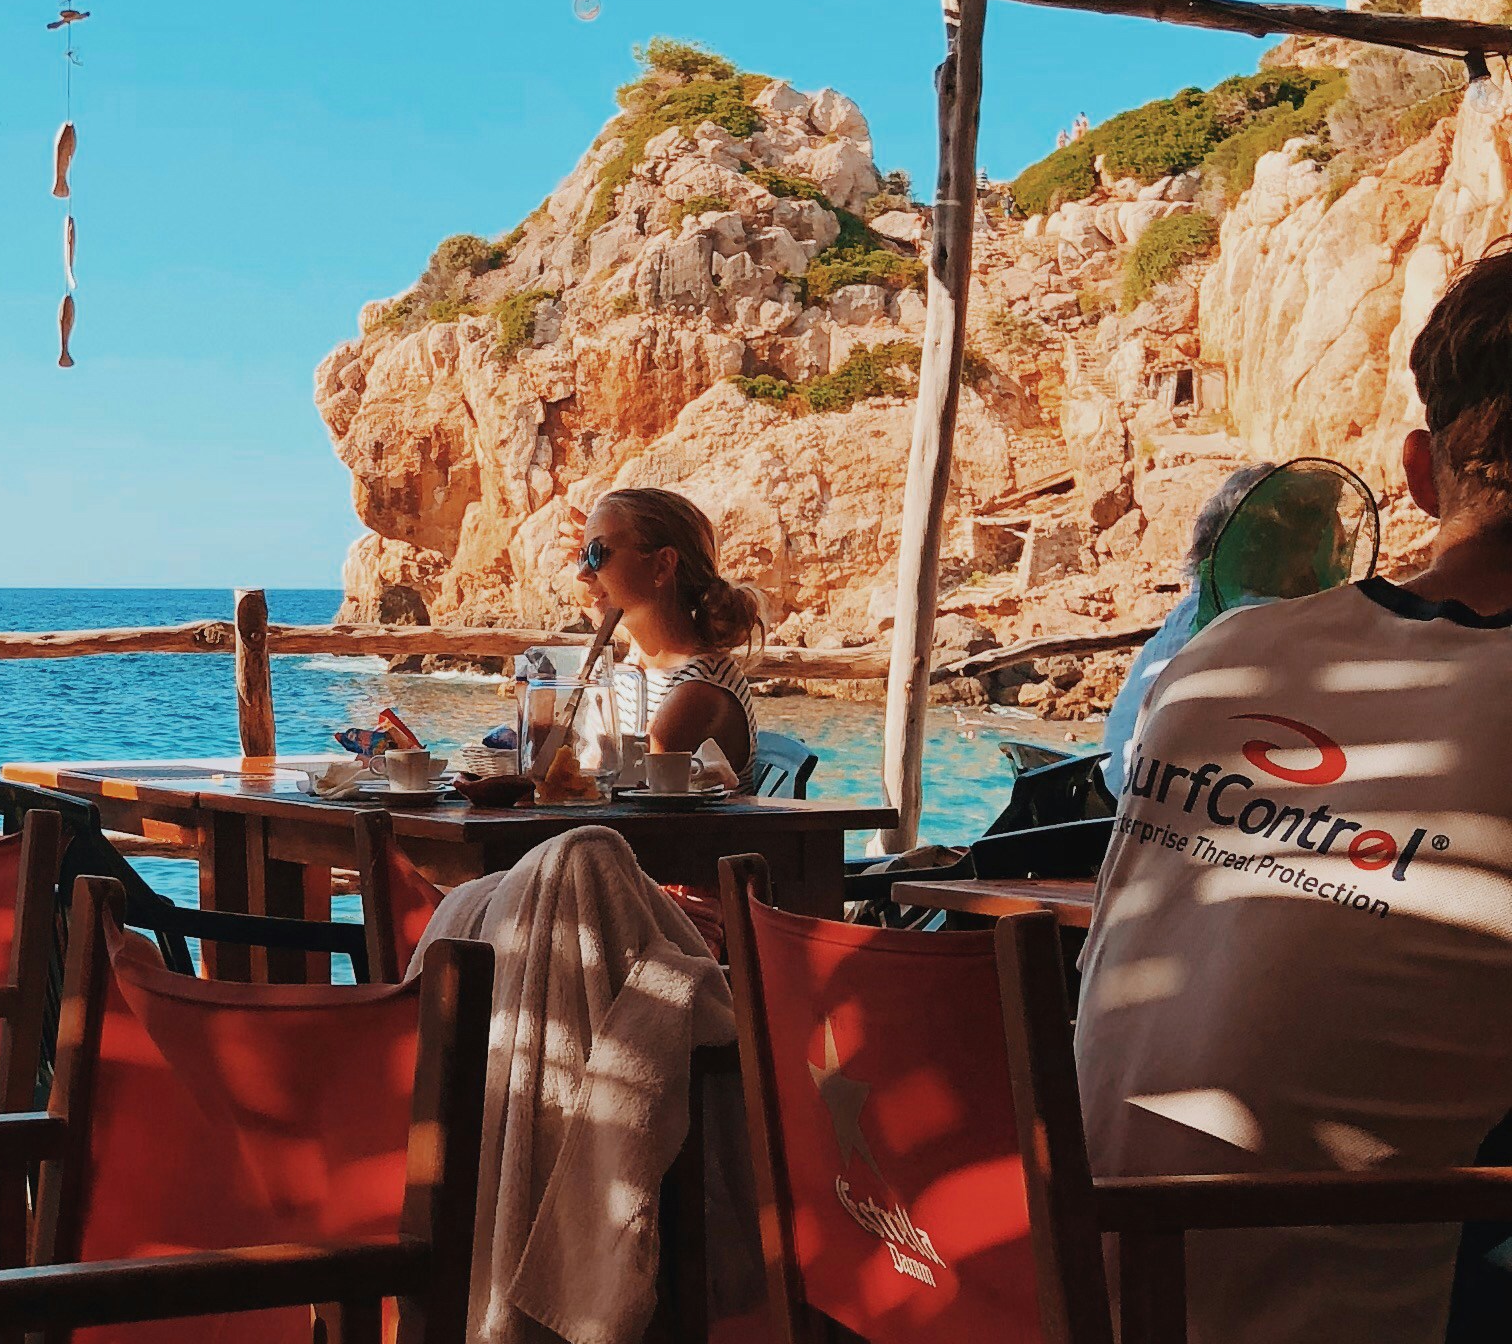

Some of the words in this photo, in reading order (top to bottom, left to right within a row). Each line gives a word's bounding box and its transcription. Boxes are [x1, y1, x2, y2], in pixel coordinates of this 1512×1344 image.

[1114, 812, 1189, 852] terprise
[1191, 835, 1257, 872] Threat
[1254, 854, 1391, 919] Protection
